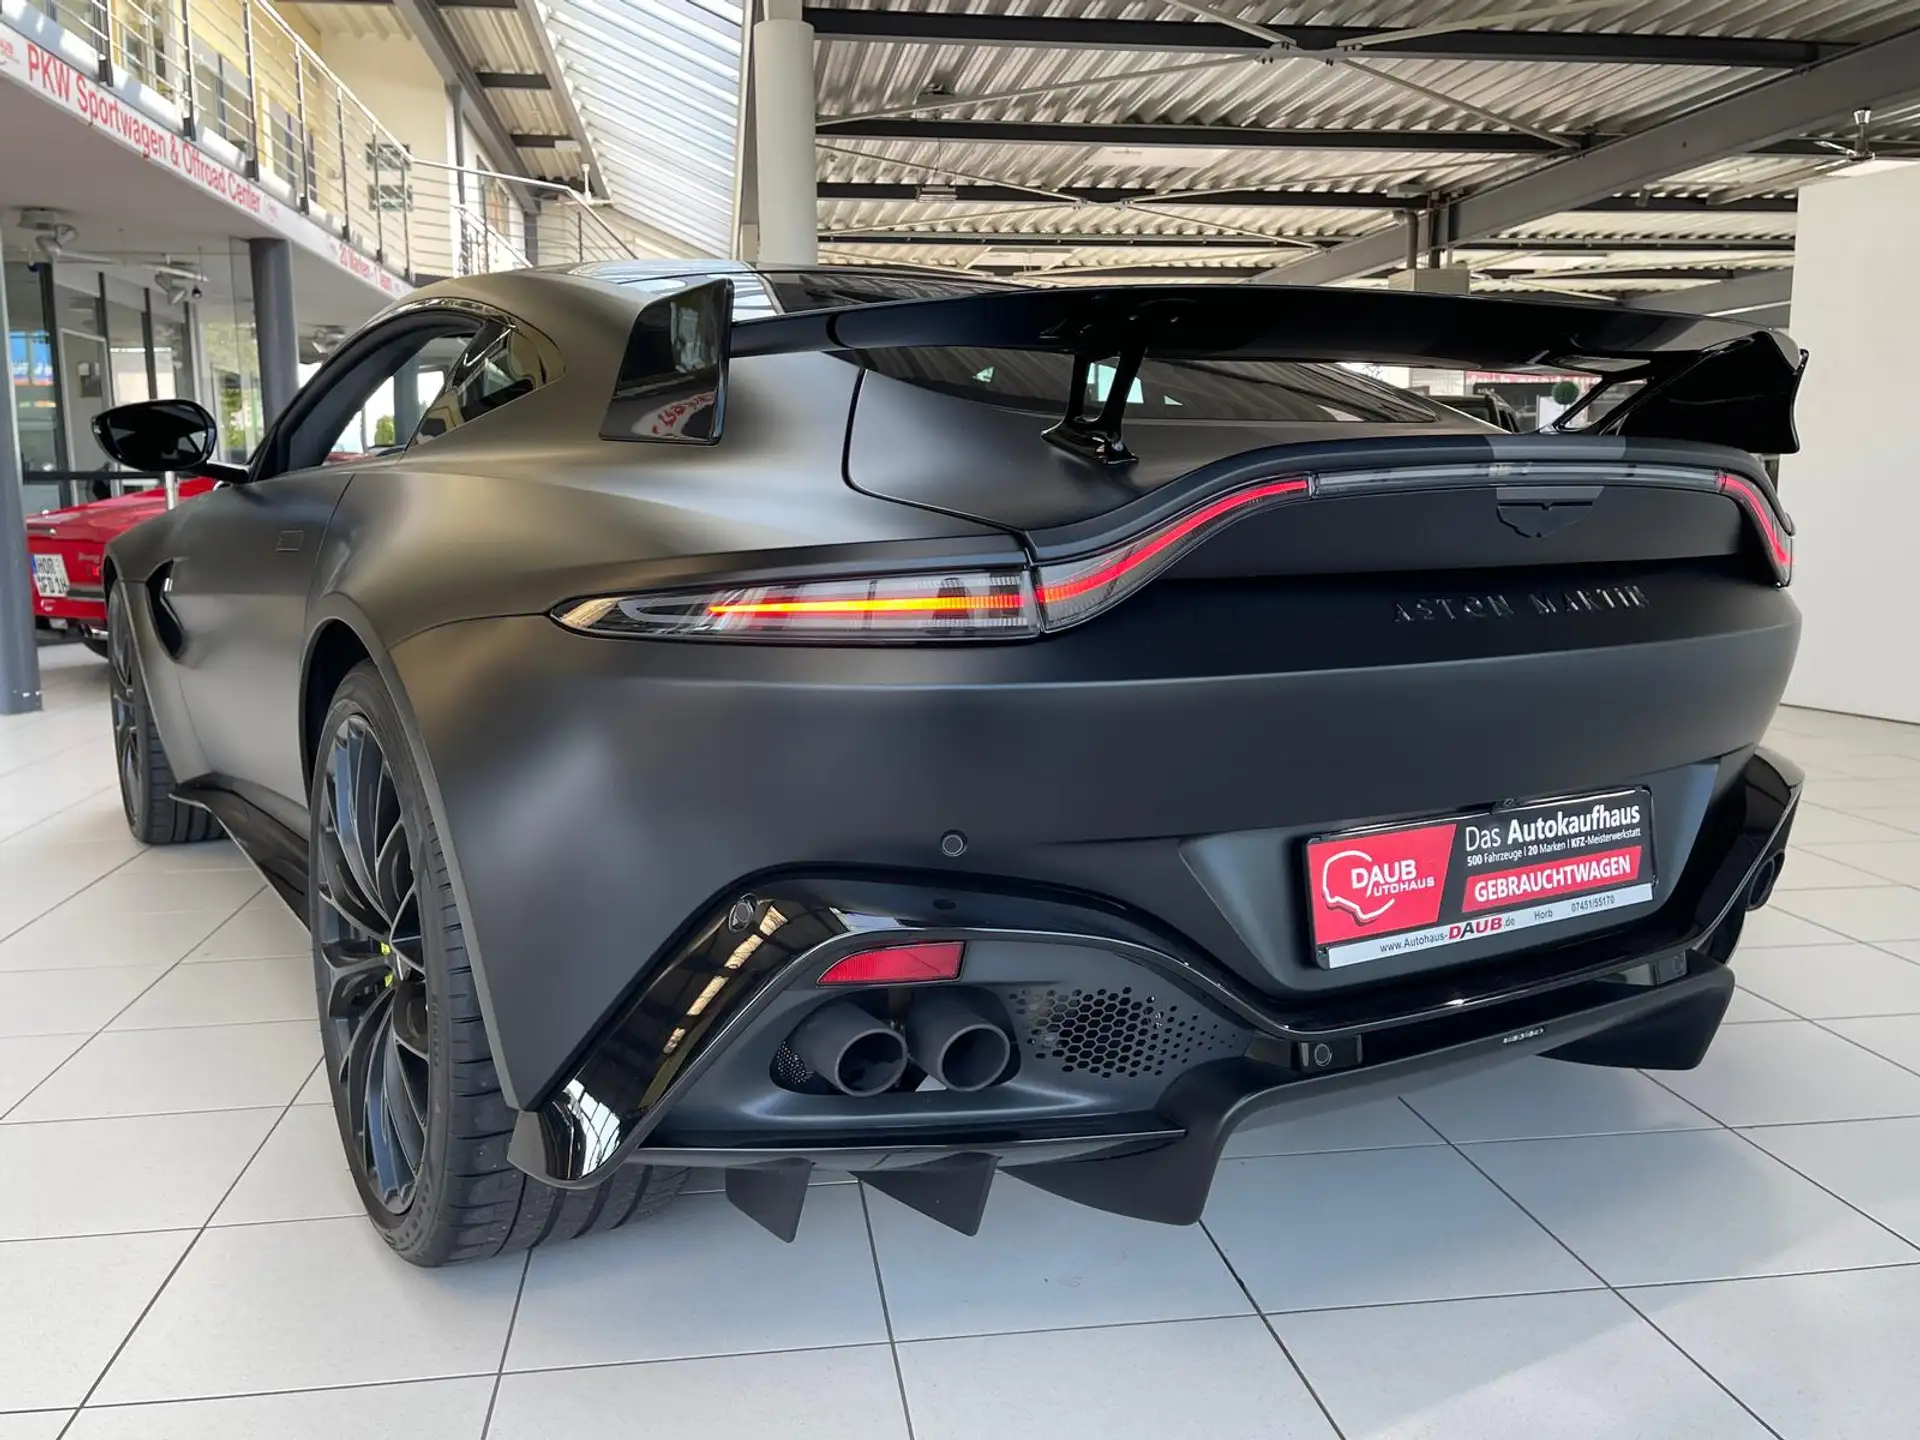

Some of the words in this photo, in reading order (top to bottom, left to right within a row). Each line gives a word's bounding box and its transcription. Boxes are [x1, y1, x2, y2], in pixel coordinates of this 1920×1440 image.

[27, 42, 71, 102] PKW
[76, 73, 166, 158] Sportwagen
[170, 134, 179, 168] &
[182, 141, 226, 194] Offroad
[228, 171, 261, 213] Center
[1393, 594, 1515, 622] ASTON
[1528, 585, 1649, 614] MARTIN
[1465, 826, 1502, 852] Das
[1507, 803, 1641, 845] Autokaufhaus
[1467, 853, 1482, 867] 500
[1484, 849, 1523, 862] Fahrzeuge
[1527, 844, 1539, 856] 20
[1540, 840, 1566, 854] Marken
[1571, 827, 1641, 849] KFZ-Meisterwerkstatt
[1351, 859, 1417, 898] DAUB
[1474, 854, 1631, 902] GEBRAUCHTWAGEN
[1534, 908, 1553, 920] Horb
